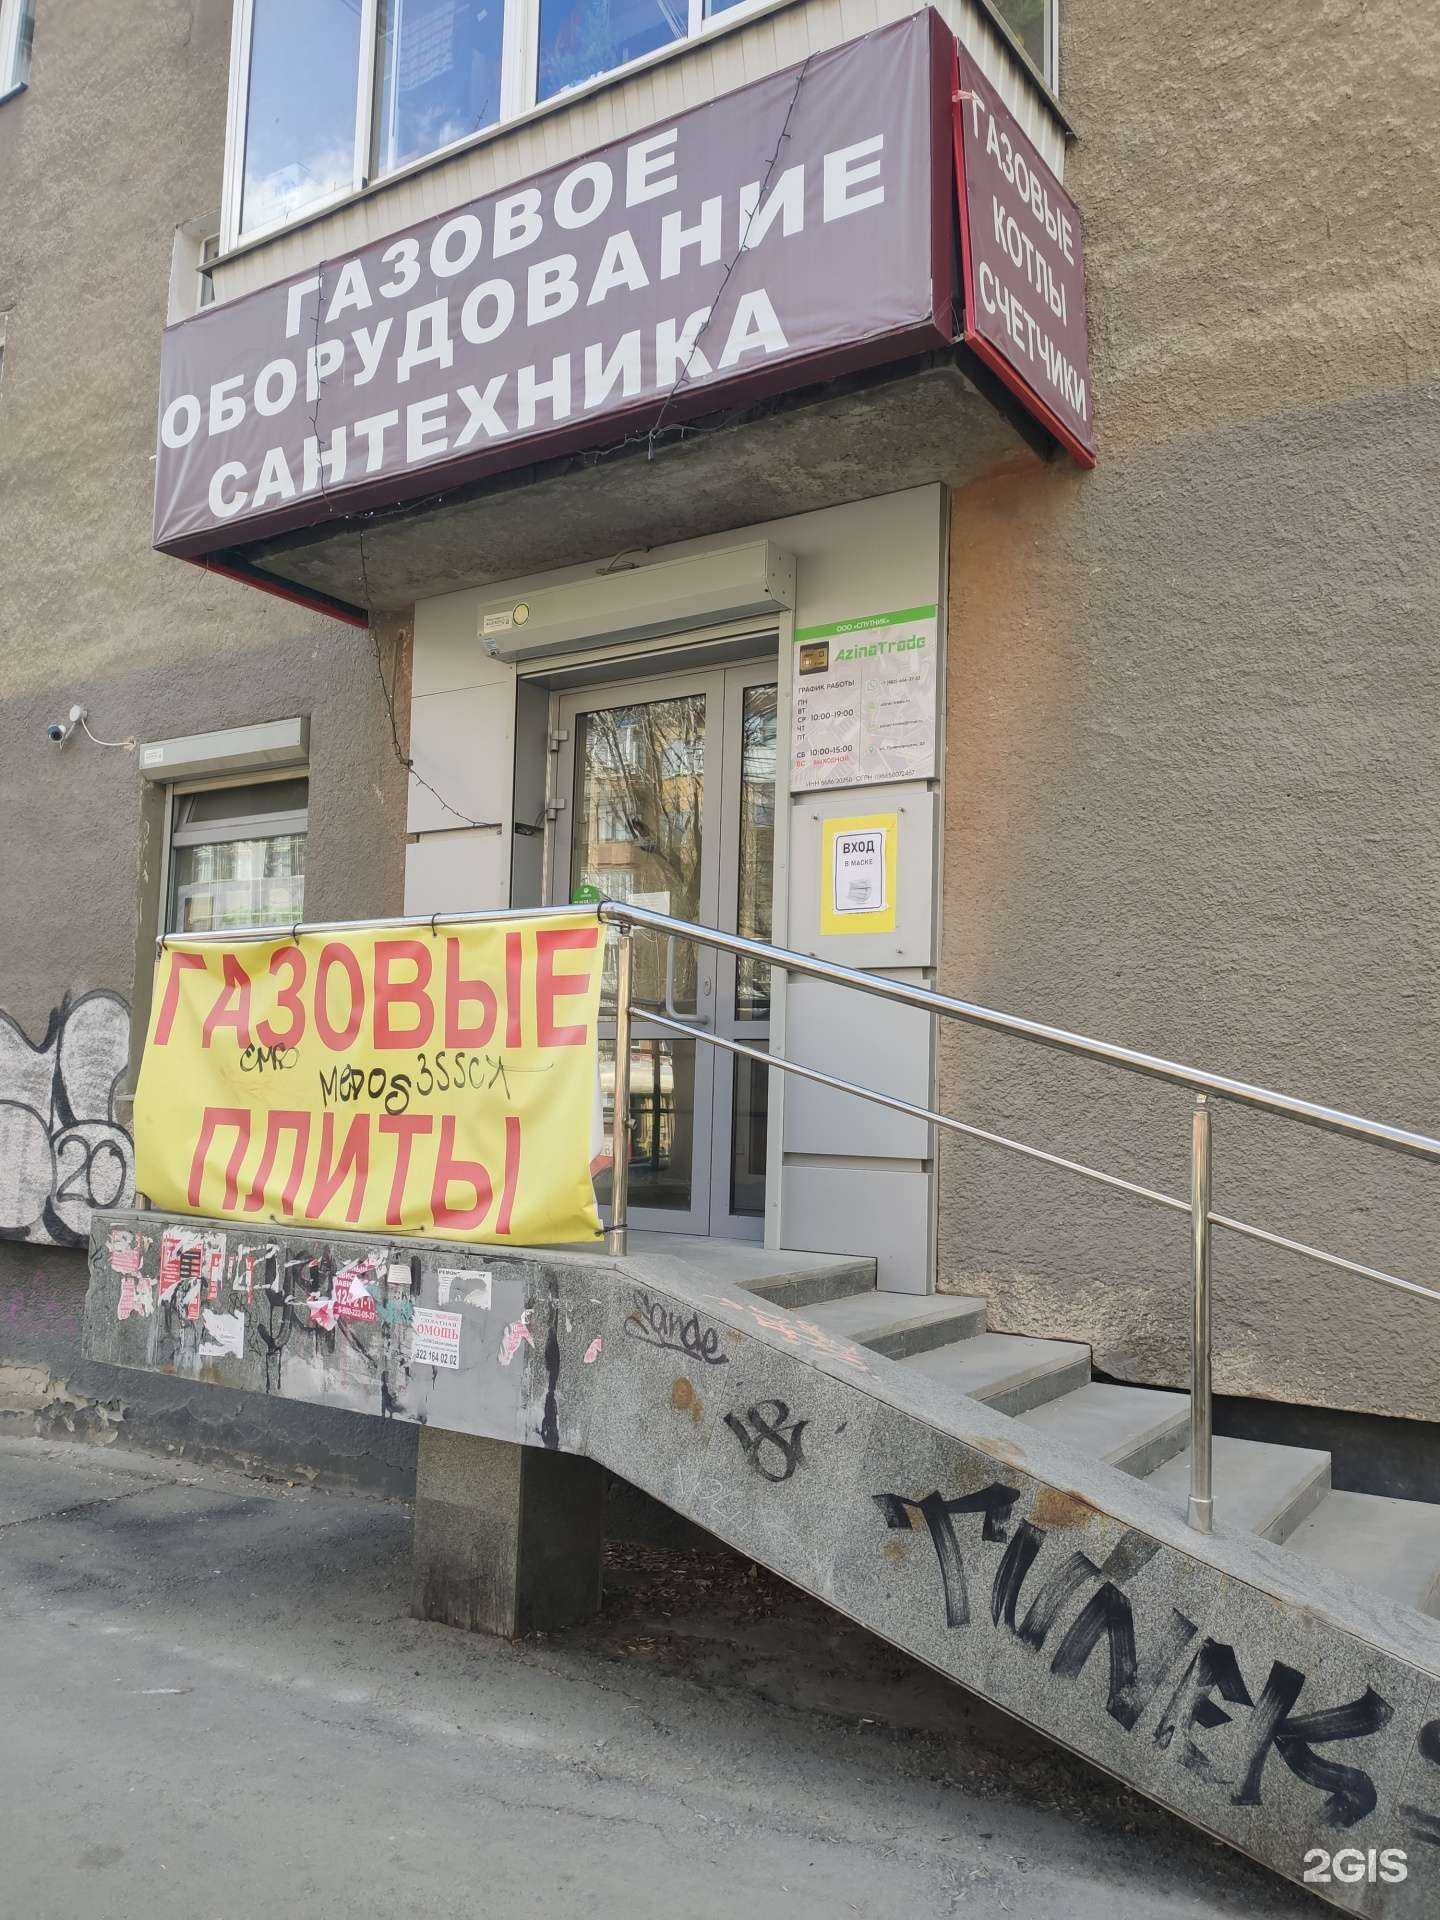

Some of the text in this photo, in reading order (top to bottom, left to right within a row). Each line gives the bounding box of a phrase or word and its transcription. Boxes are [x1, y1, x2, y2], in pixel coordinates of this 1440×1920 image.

[971, 93, 1074, 266] ГАЗОВЫЕ
[286, 128, 679, 339] ГАЗОВОЕ
[992, 195, 1068, 327] КОТЛЫ
[161, 134, 886, 450] ОБОРУДОВАНИЕ
[979, 261, 1087, 421] СЧЕТЧИКИ
[208, 288, 790, 518] САНТЕХНИКА
[836, 623, 852, 632] ООО
[834, 634, 927, 662] AzinaTrade
[798, 680, 855, 694] ГРАФИК РАБОТЫ
[797, 699, 808, 707] ПН
[797, 707, 806, 715] ВТ
[797, 716, 807, 724] СР
[797, 733, 806, 741] ПТ
[796, 751, 806, 759] СБ
[843, 840, 875, 854] ВХОД
[851, 858, 873, 867] МАСКЕ
[153, 928, 599, 1050] ГАЗОВЫЕ
[188, 1107, 521, 1235] ПЛИТЫ
[440, 1353, 449, 1365] 02
[449, 1354, 457, 1366] 02
